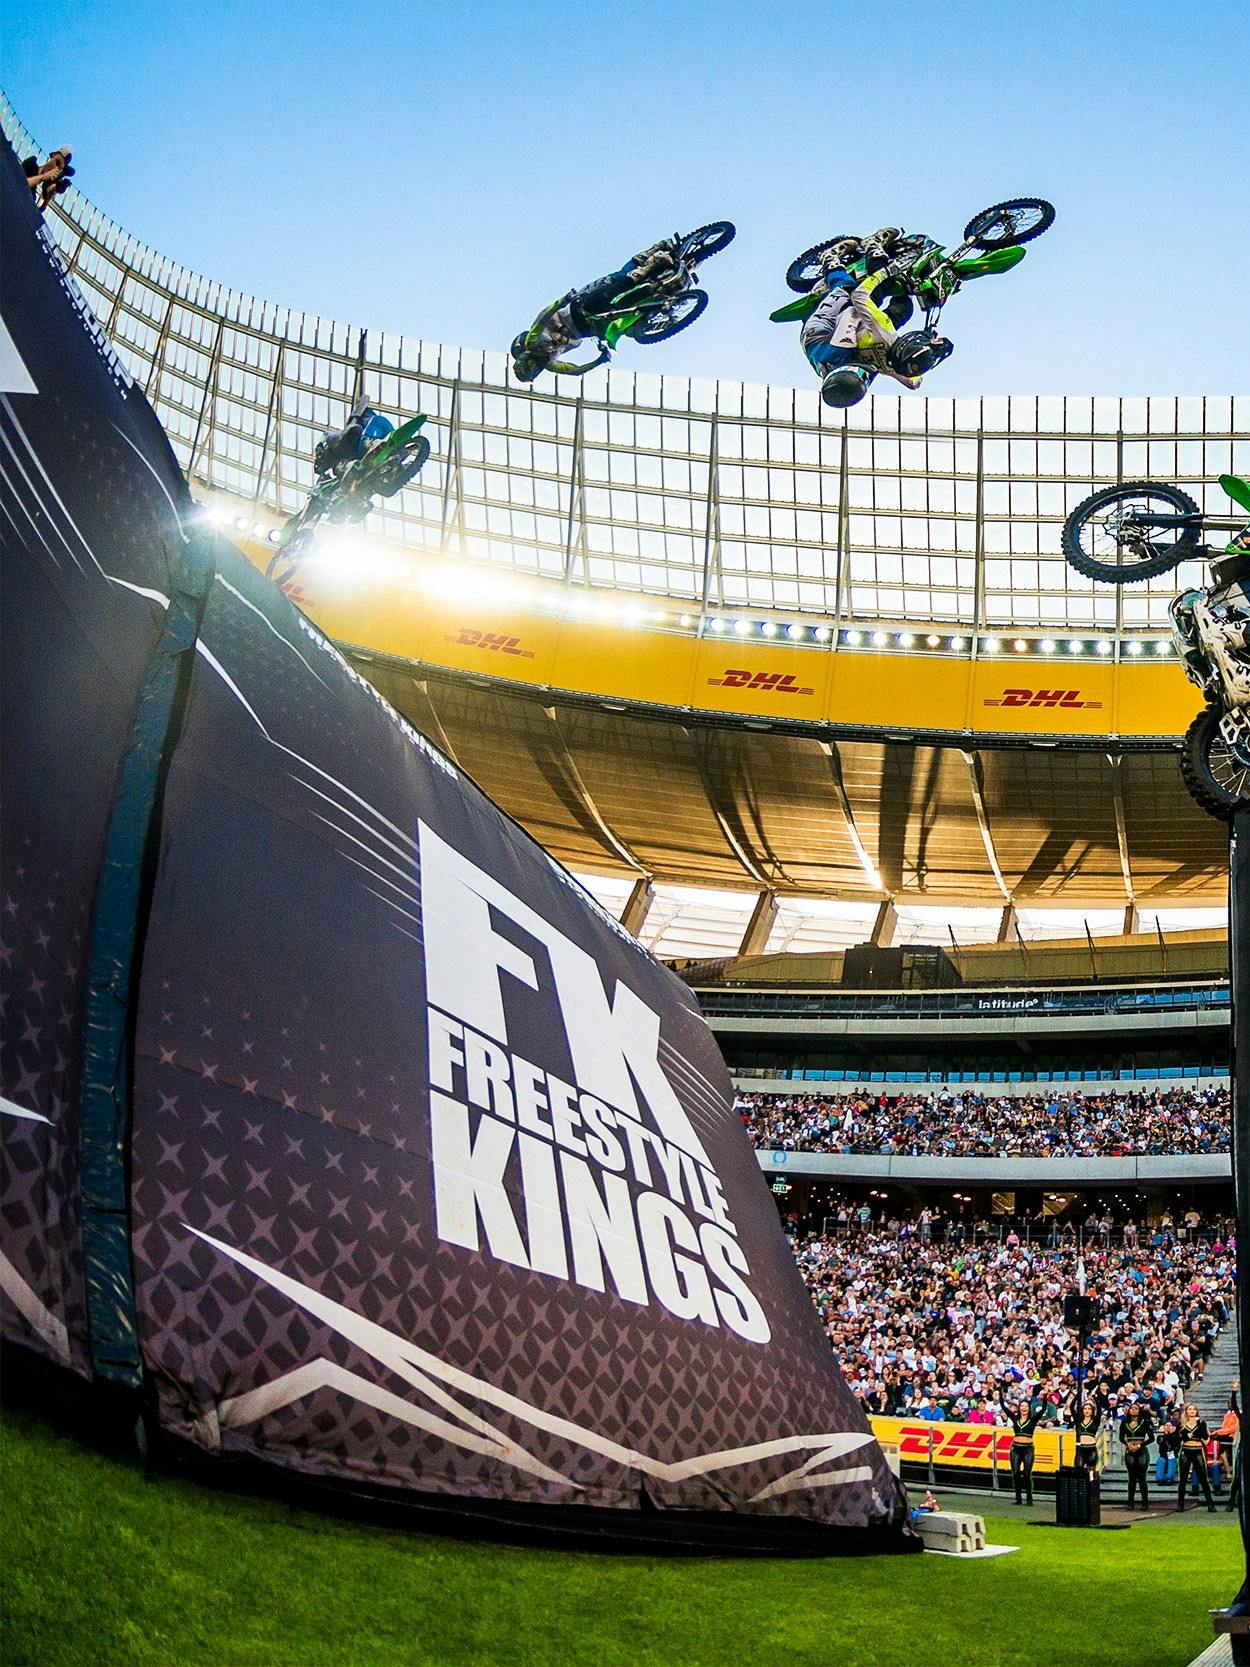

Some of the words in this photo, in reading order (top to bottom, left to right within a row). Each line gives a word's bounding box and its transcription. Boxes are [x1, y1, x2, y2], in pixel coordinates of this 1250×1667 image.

[455, 628, 522, 656] DHL
[721, 669, 802, 694] DHL
[1000, 689, 1089, 708] DHL
[418, 818, 715, 1172] FK
[428, 1006, 738, 1237] FREESTYLE
[430, 1090, 772, 1345] KINGS
[899, 1426, 1016, 1461] DHL
